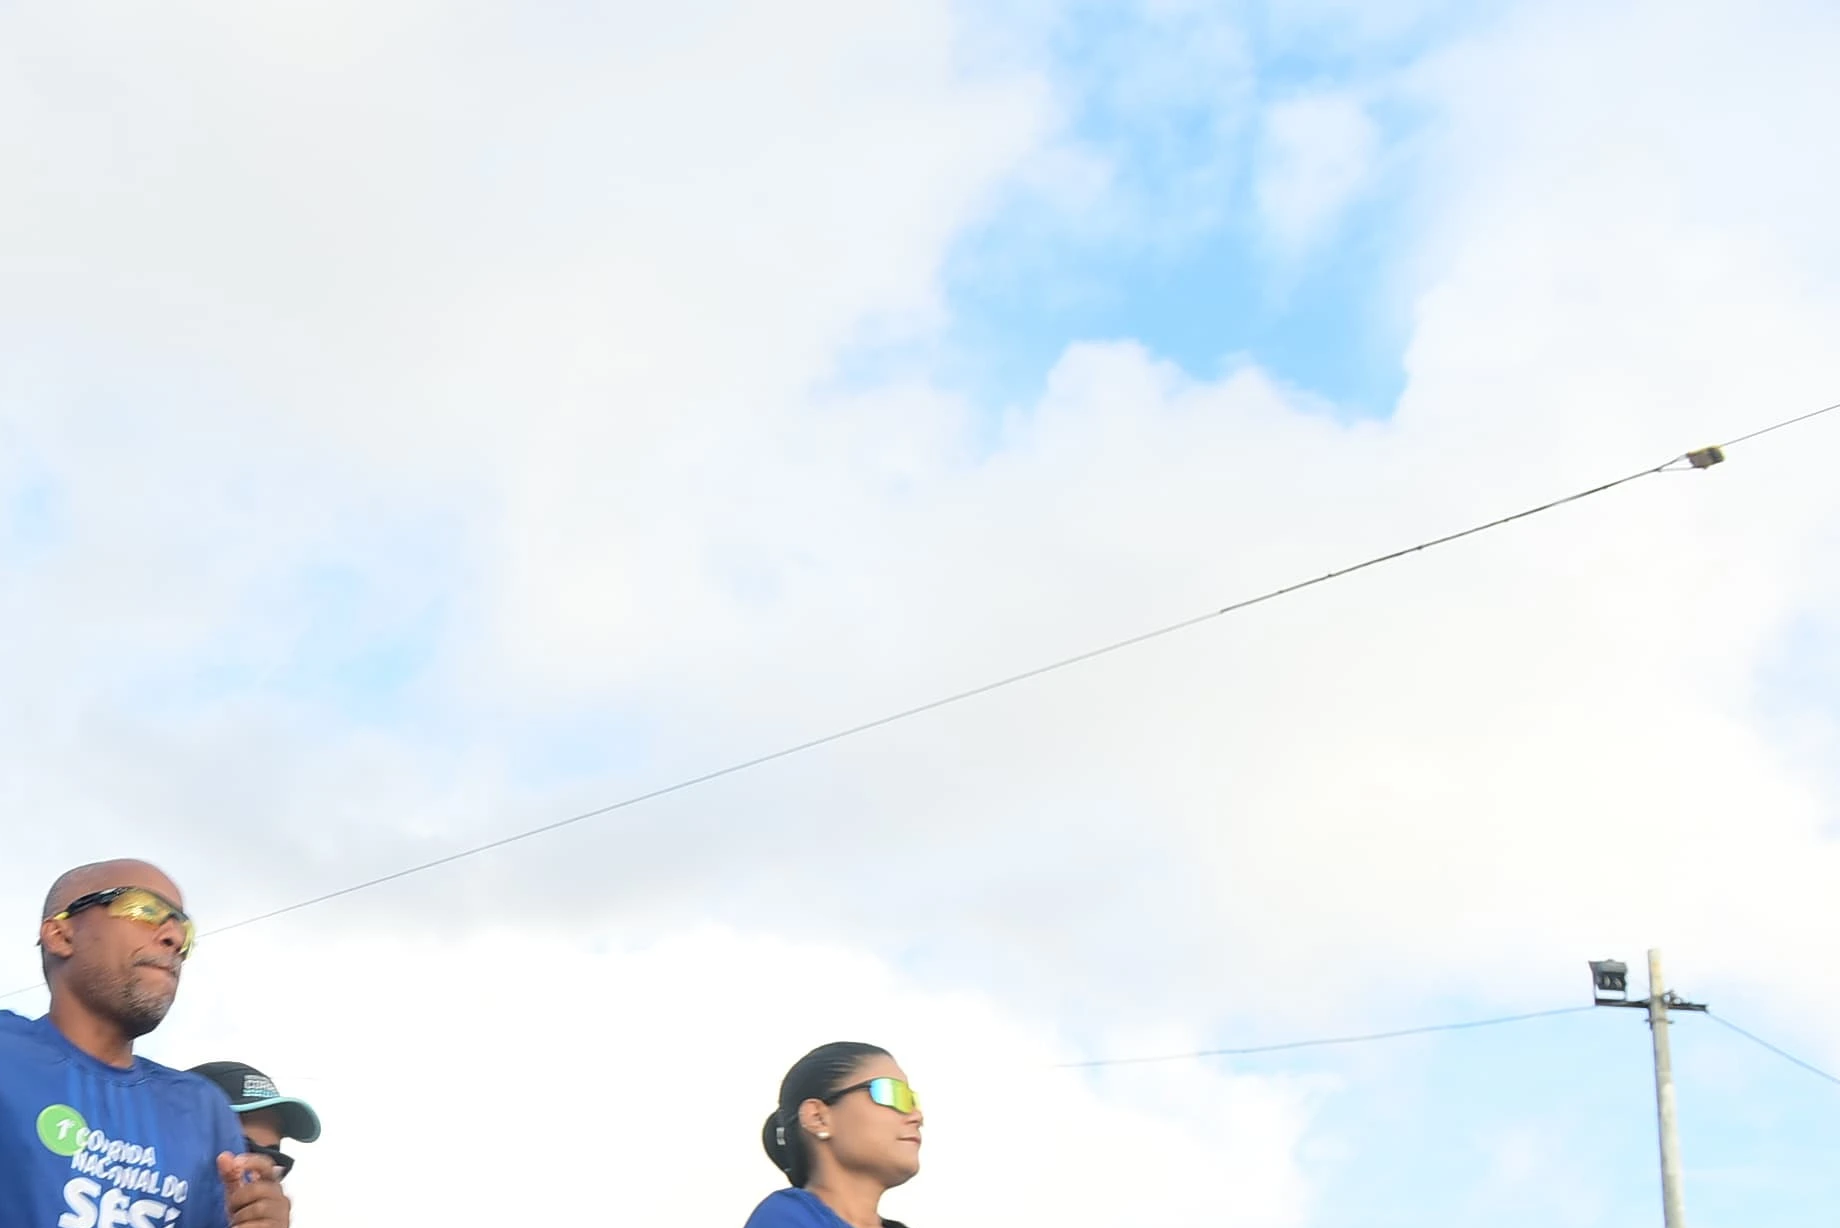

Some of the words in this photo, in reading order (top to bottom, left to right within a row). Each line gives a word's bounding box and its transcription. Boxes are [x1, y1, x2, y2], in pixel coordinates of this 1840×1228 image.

[76, 1127, 156, 1167] CORRIDA
[71, 1150, 160, 1195] NACIONAL
[161, 1174, 189, 1204] DO
